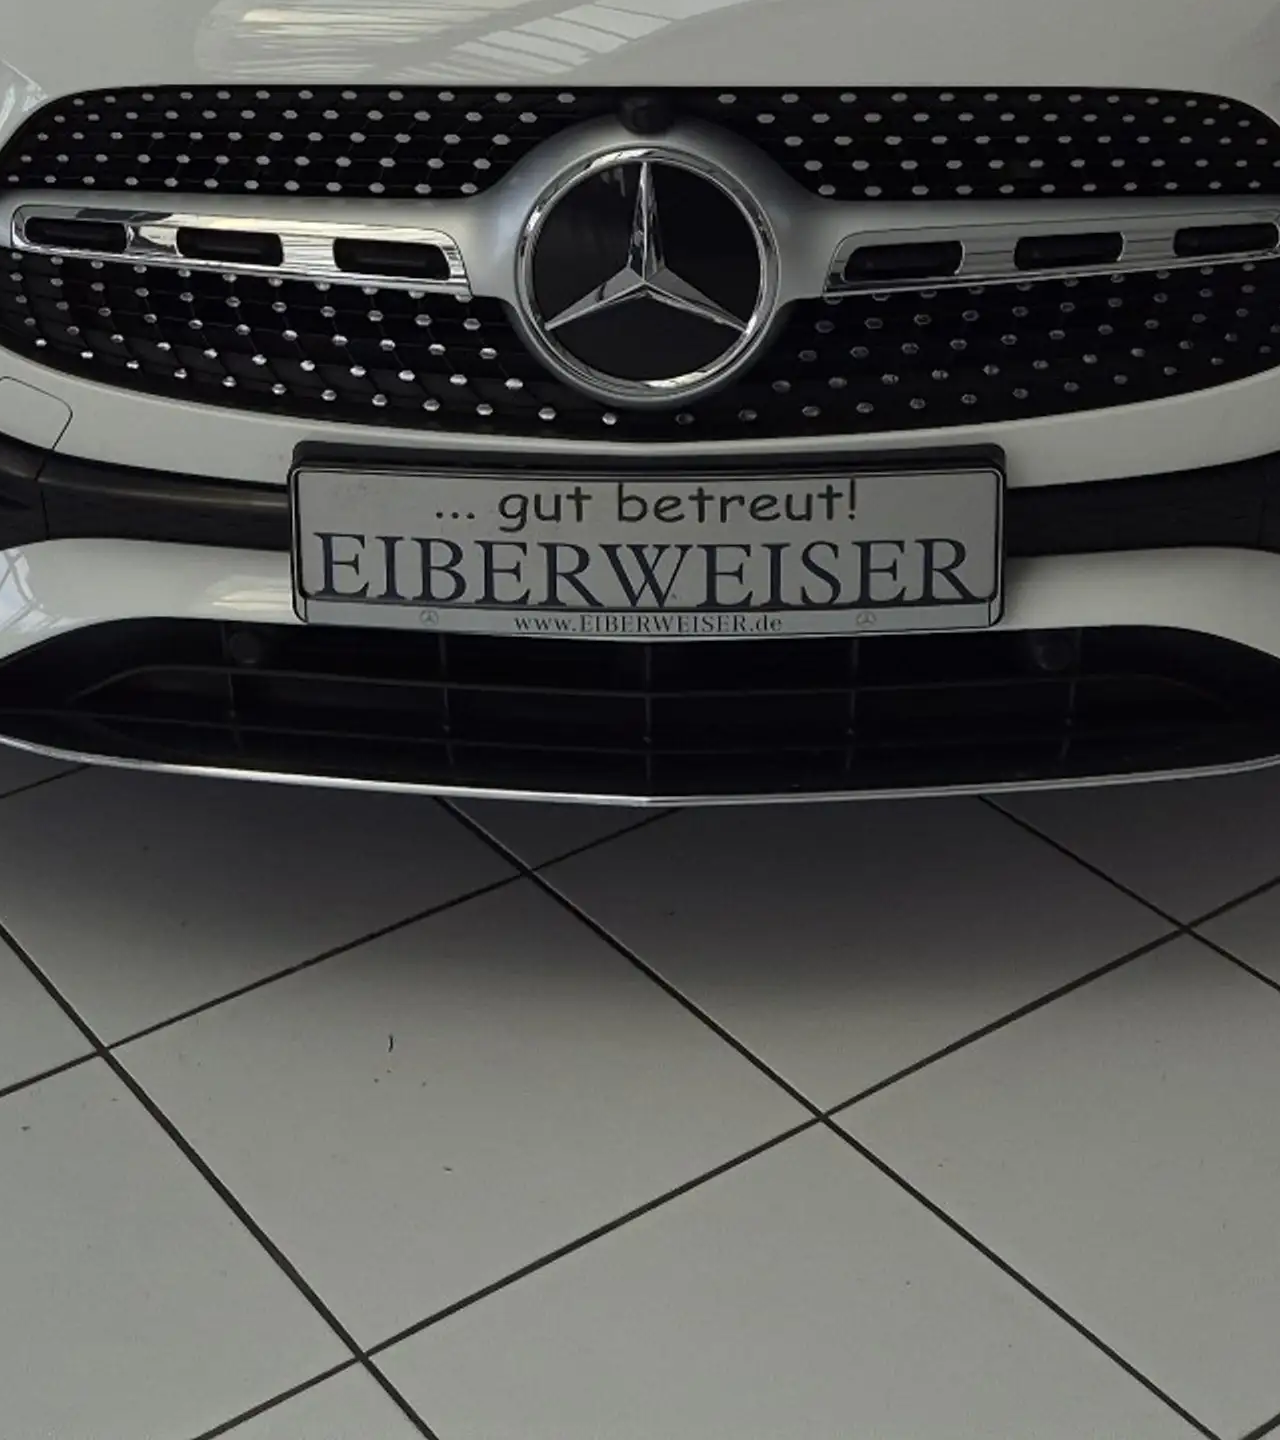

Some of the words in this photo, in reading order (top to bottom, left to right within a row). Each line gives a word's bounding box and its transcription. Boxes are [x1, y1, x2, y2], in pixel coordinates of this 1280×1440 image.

[499, 486, 593, 533] gut
[618, 479, 857, 523] betreut!
[313, 532, 992, 610] EIBERWEISER
[514, 614, 783, 634] www.EIBERWEISER.de
